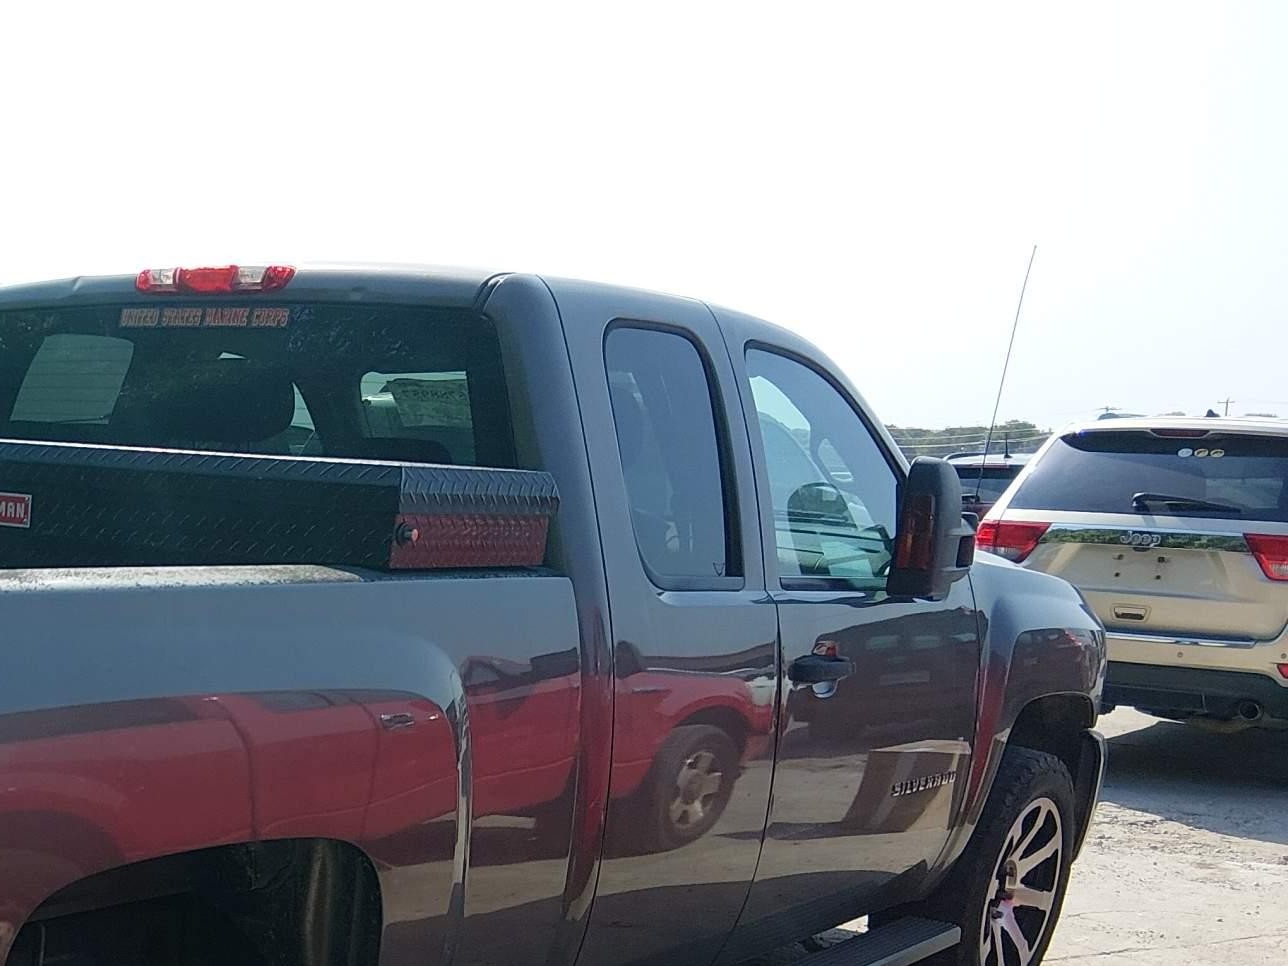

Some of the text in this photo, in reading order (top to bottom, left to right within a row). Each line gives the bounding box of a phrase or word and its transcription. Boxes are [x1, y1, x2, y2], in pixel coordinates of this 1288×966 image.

[120, 307, 289, 327] UNITED STATES MARINE CORPS
[1119, 530, 1162, 548] Jeep
[892, 769, 956, 797] SILVERADO
